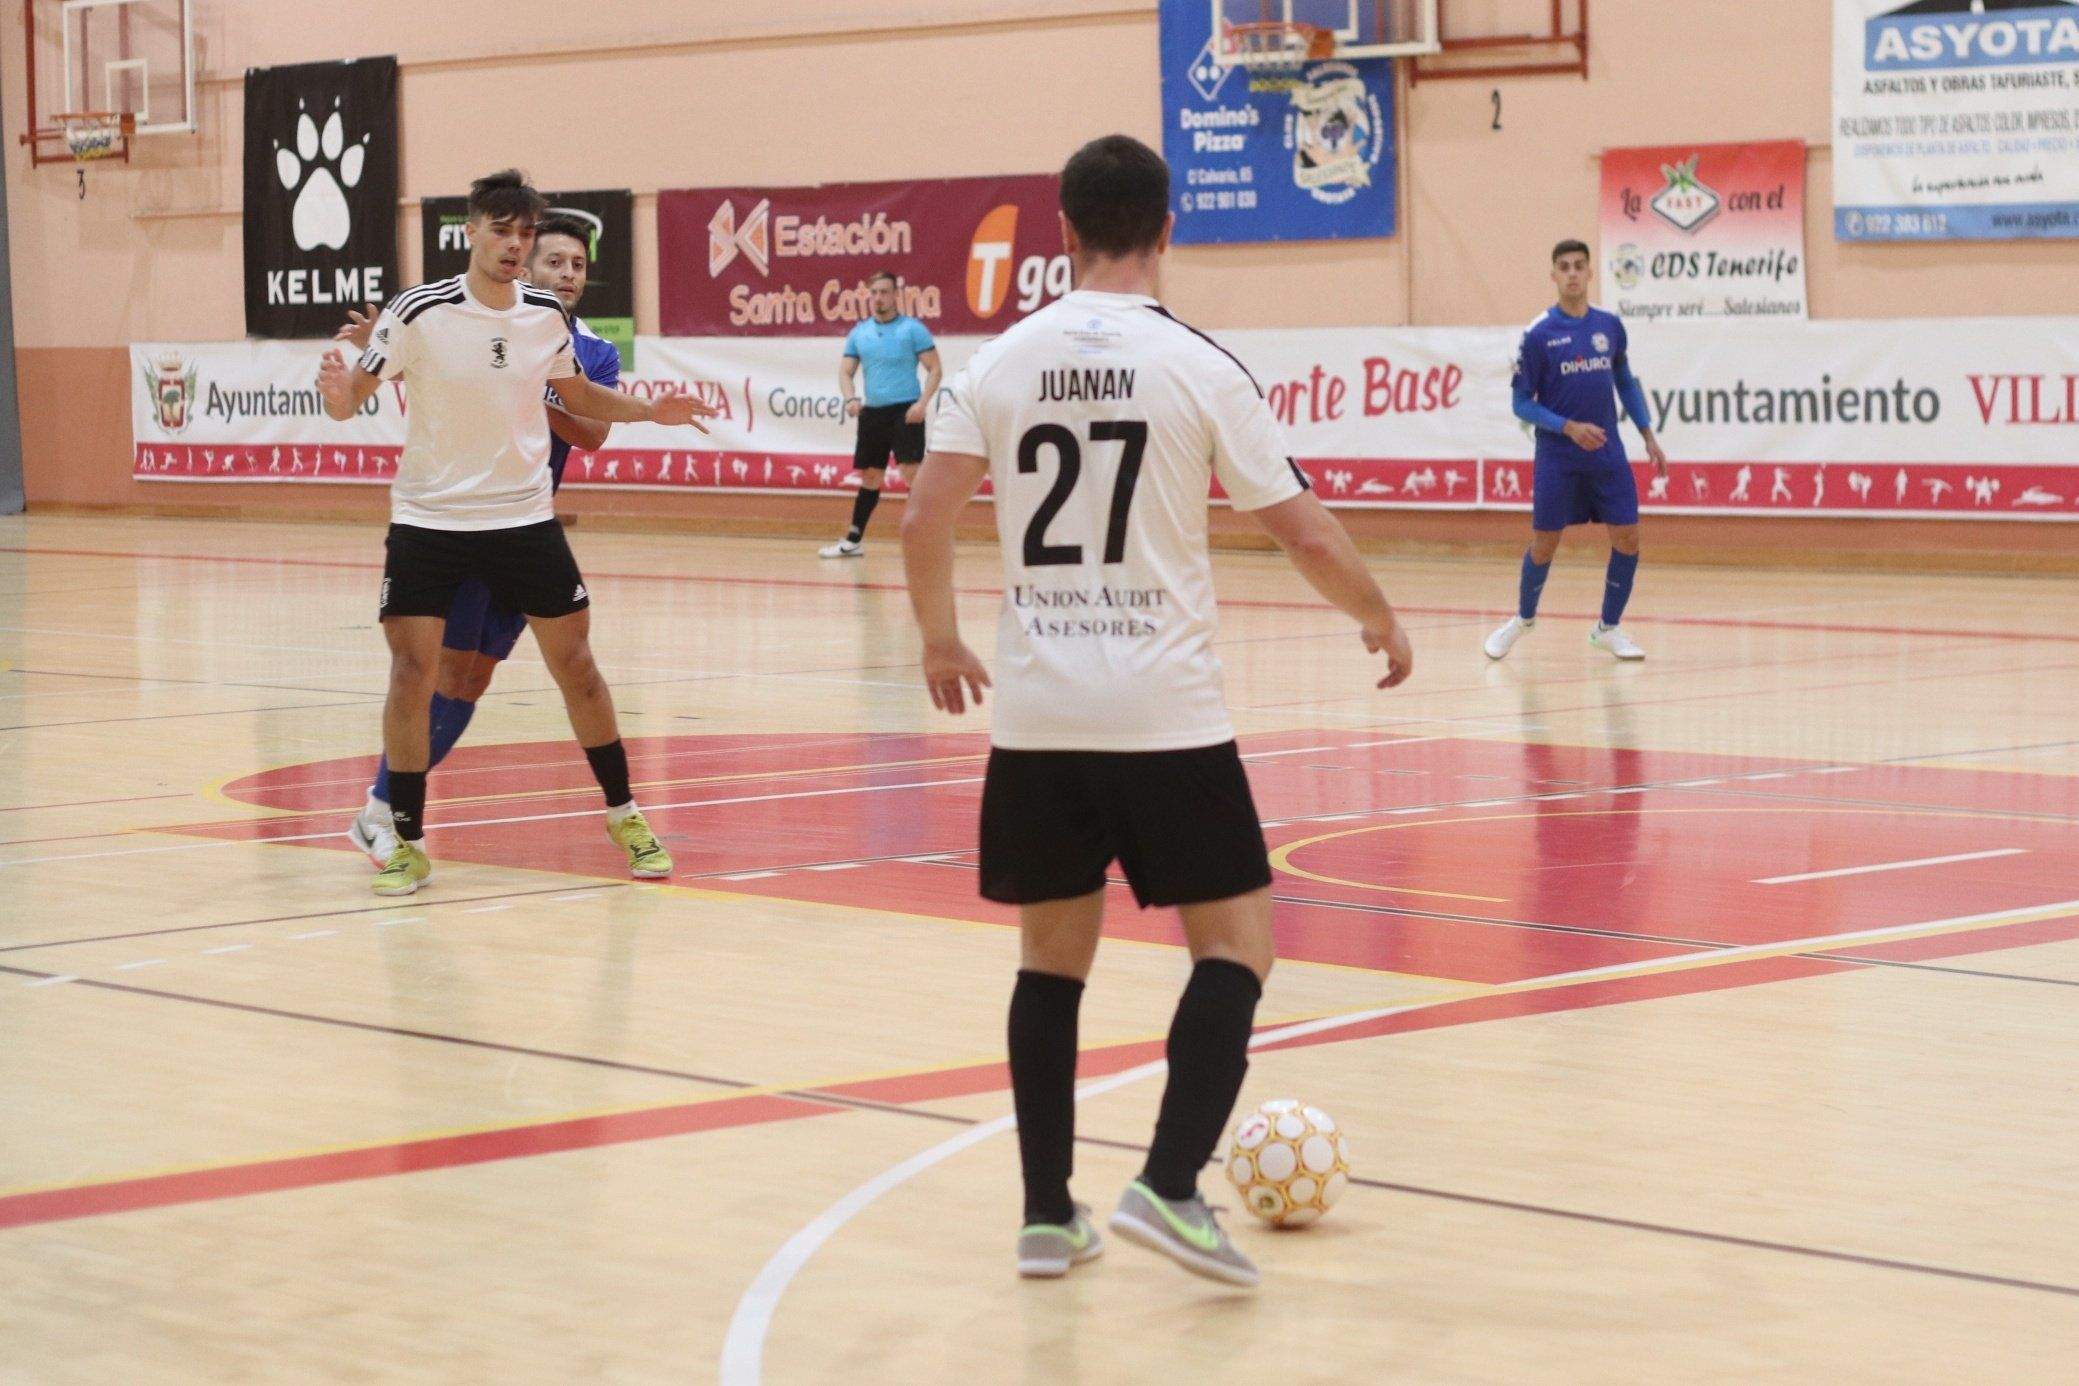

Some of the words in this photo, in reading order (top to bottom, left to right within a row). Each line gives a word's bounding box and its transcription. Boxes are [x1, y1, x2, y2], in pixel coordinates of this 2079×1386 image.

[1864, 76, 1926, 94] ASFALTOS
[1930, 76, 1938, 93] Y
[1943, 74, 1986, 92] OBRAS
[1180, 104, 1260, 130] Domino's
[1491, 90, 1502, 130] 2
[1193, 130, 1246, 153] Pizza
[76, 168, 85, 200] 3
[1728, 191, 1762, 211] con
[1766, 185, 1785, 210] el
[776, 212, 912, 257] Estación
[1651, 252, 1700, 279] CDS
[1706, 248, 1798, 283] Tenerife
[267, 266, 384, 305] KELME
[729, 284, 814, 326] Santa
[820, 276, 942, 321] Catina
[206, 379, 380, 424] Ayuntamio
[1038, 368, 1136, 402] JUANAN
[1363, 356, 1463, 417] Base
[768, 387, 848, 425] Concej
[1018, 420, 1148, 567] 27
